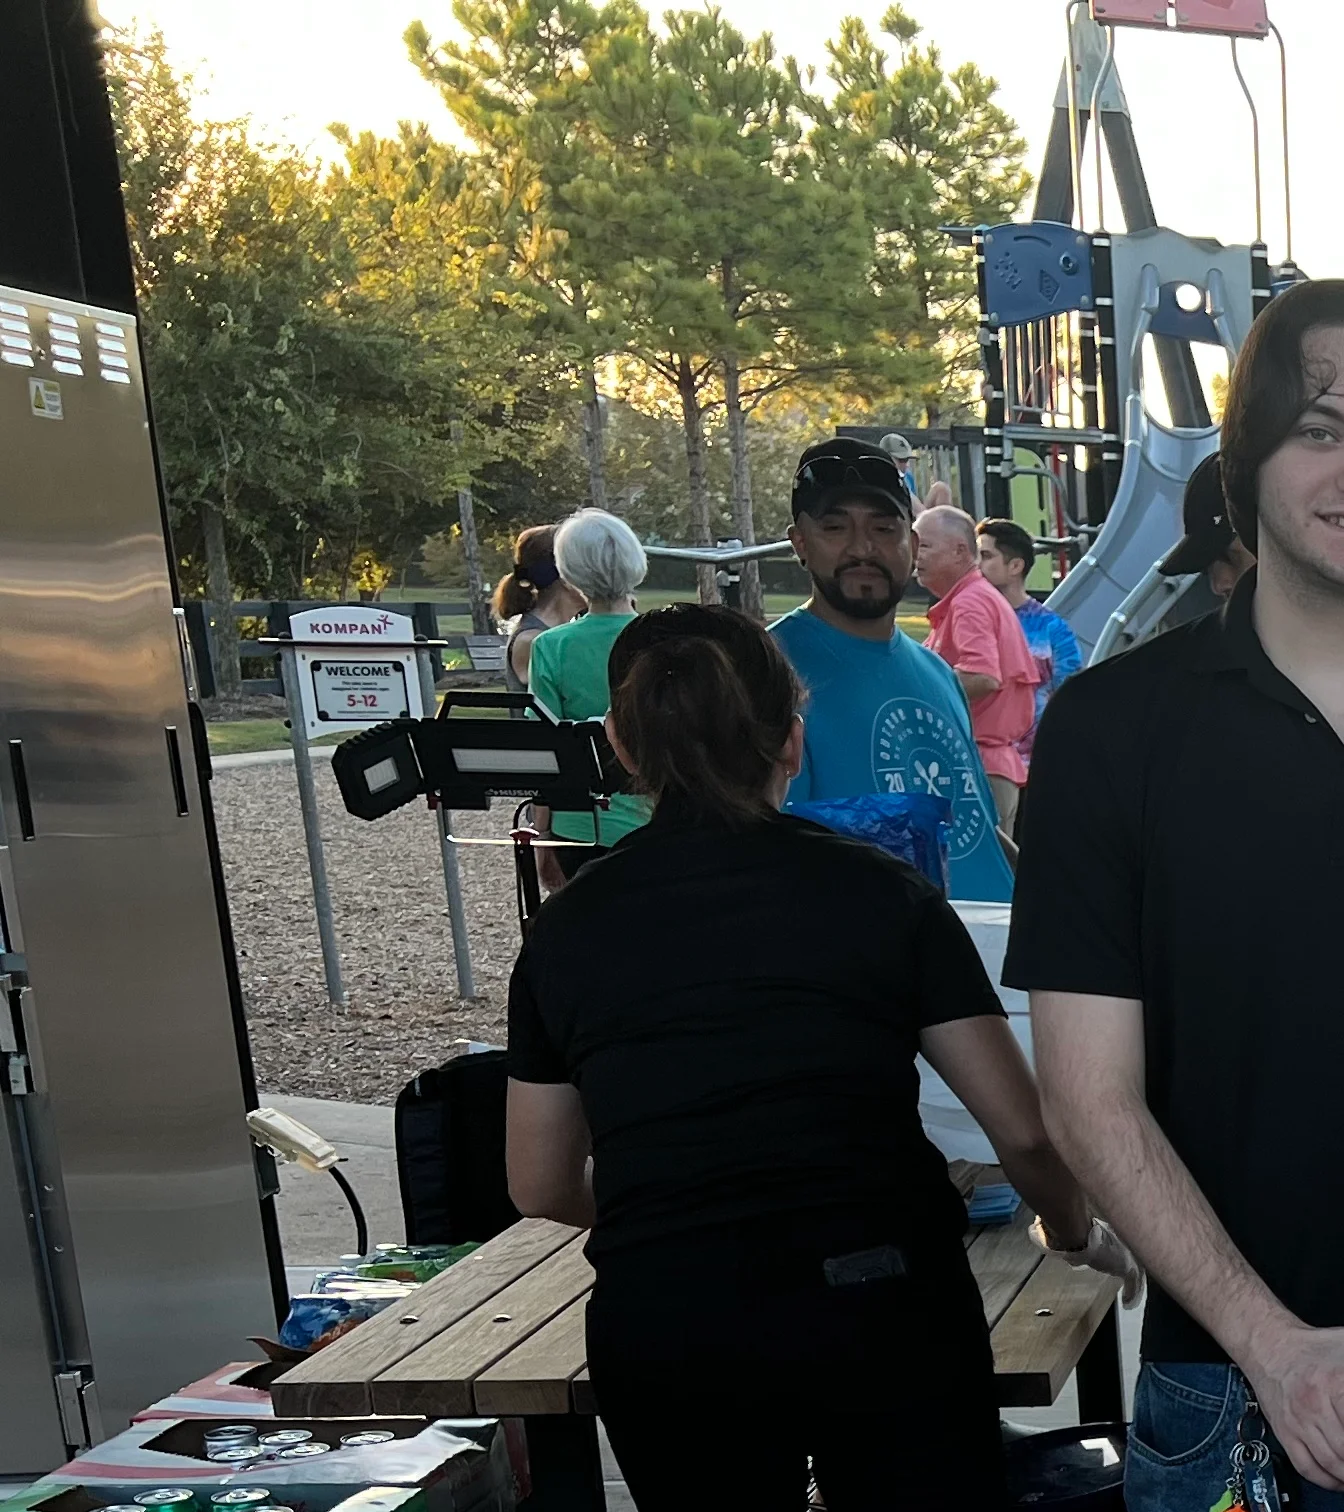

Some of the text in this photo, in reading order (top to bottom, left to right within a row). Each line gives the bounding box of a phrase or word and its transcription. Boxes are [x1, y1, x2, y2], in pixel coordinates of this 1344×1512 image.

[310, 623, 382, 634] KOMPAN
[325, 666, 391, 677] WELCOME
[347, 695, 378, 707] 5-12
[499, 789, 539, 797] HUSKY
